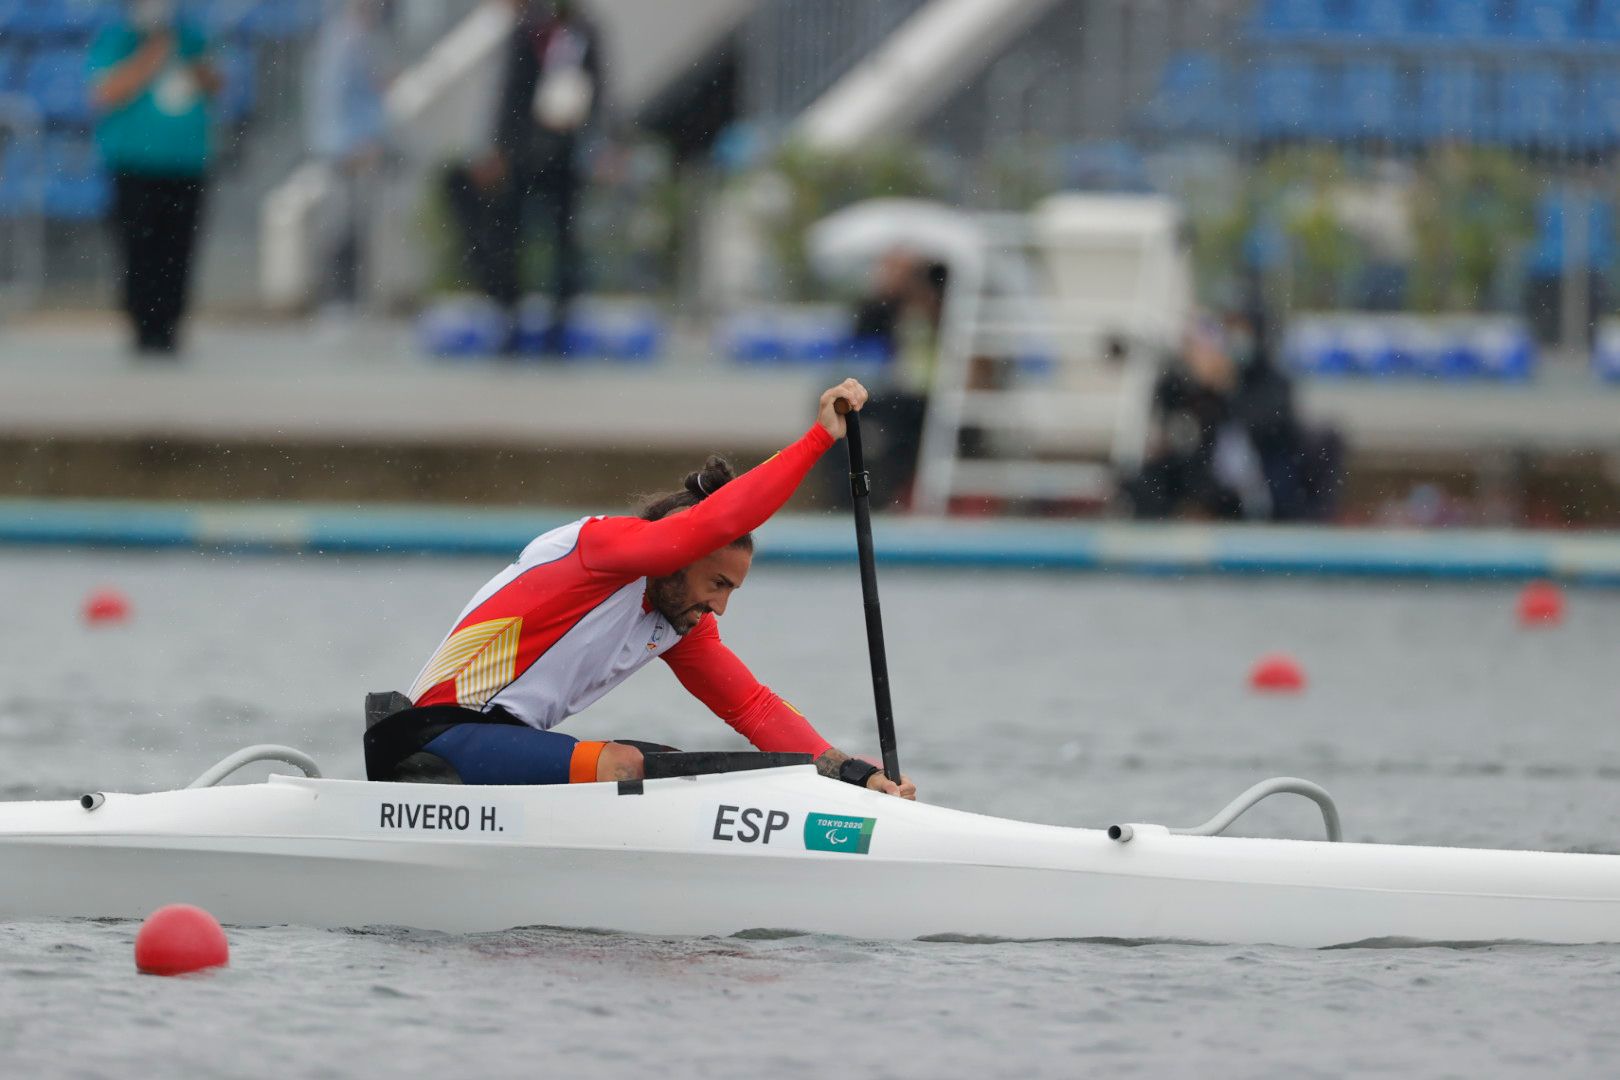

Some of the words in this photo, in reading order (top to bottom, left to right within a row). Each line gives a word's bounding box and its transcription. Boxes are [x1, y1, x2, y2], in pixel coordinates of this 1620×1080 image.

[381, 803, 469, 830] RIVERO
[480, 806, 504, 832] H.
[713, 804, 790, 844] ESP
[817, 818, 842, 828] TOKYO
[844, 821, 862, 829] 2020
